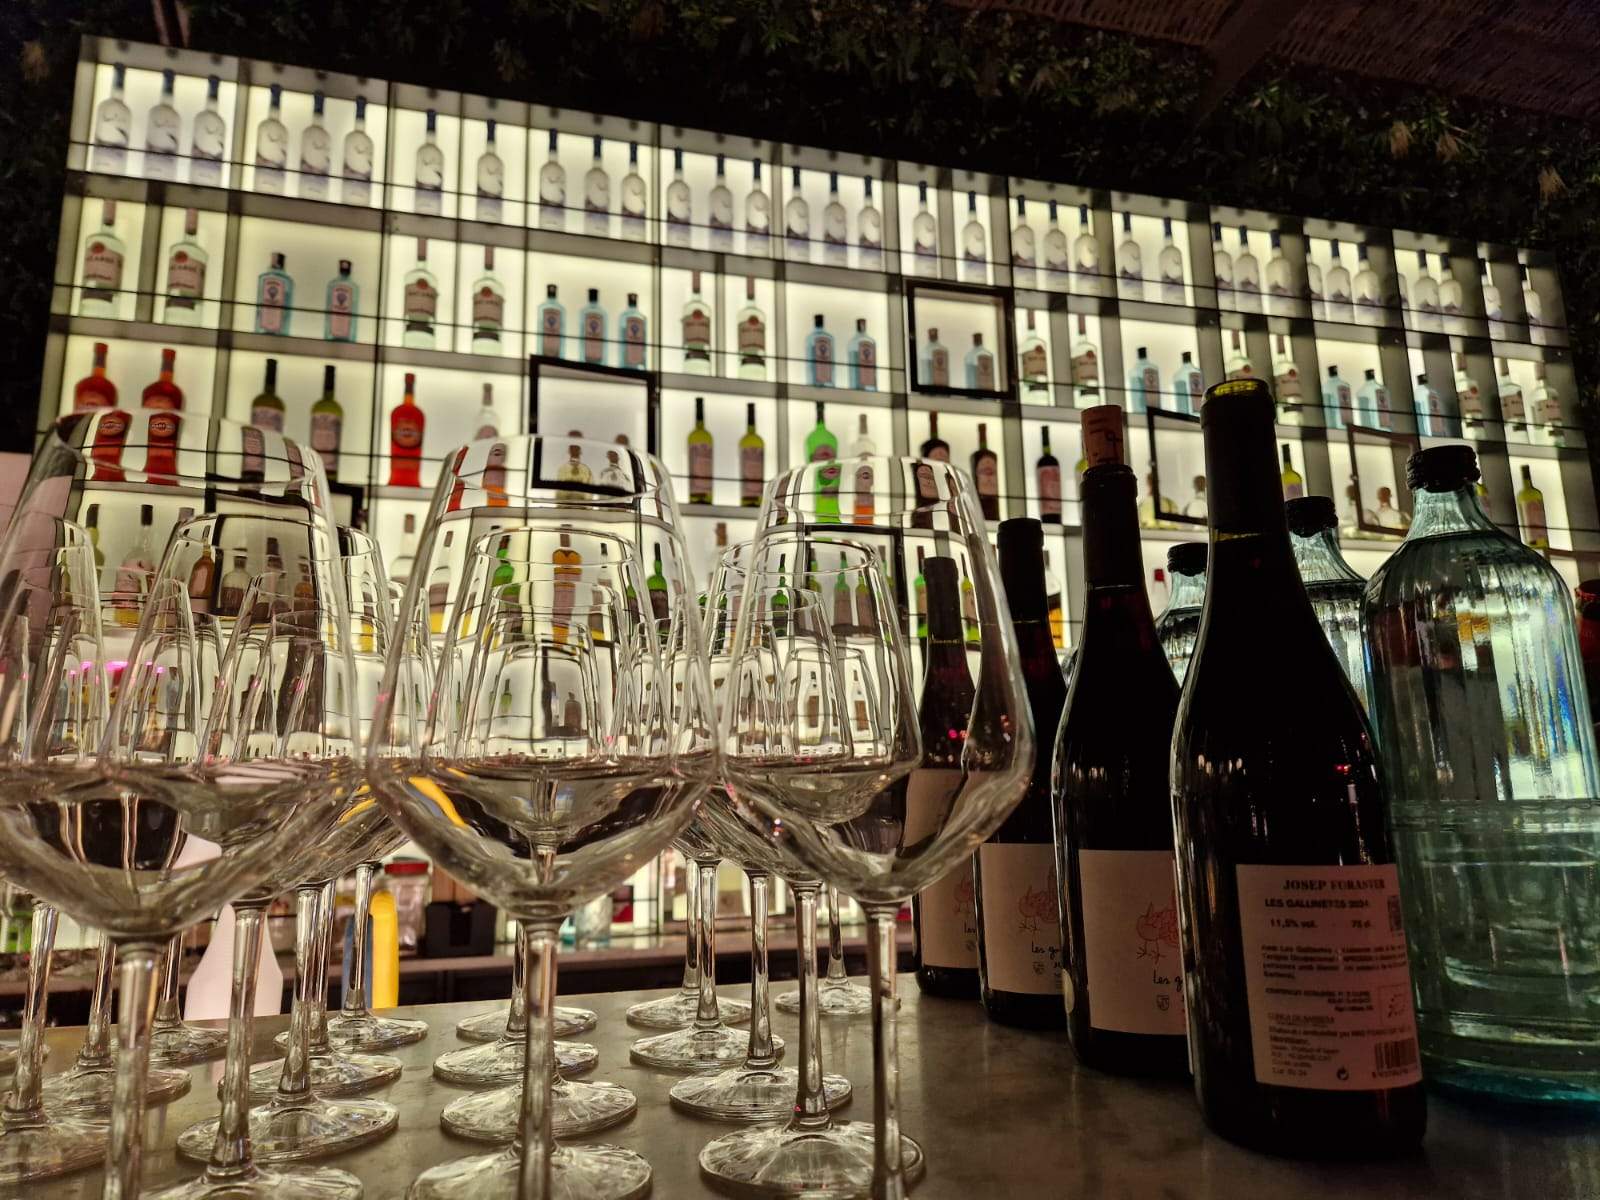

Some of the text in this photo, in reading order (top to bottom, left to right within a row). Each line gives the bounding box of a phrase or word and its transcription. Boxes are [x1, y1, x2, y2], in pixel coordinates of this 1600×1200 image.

[1283, 879, 1327, 890] JOSEP
[1264, 898, 1284, 907] LES
[1153, 968, 1171, 985] Les
